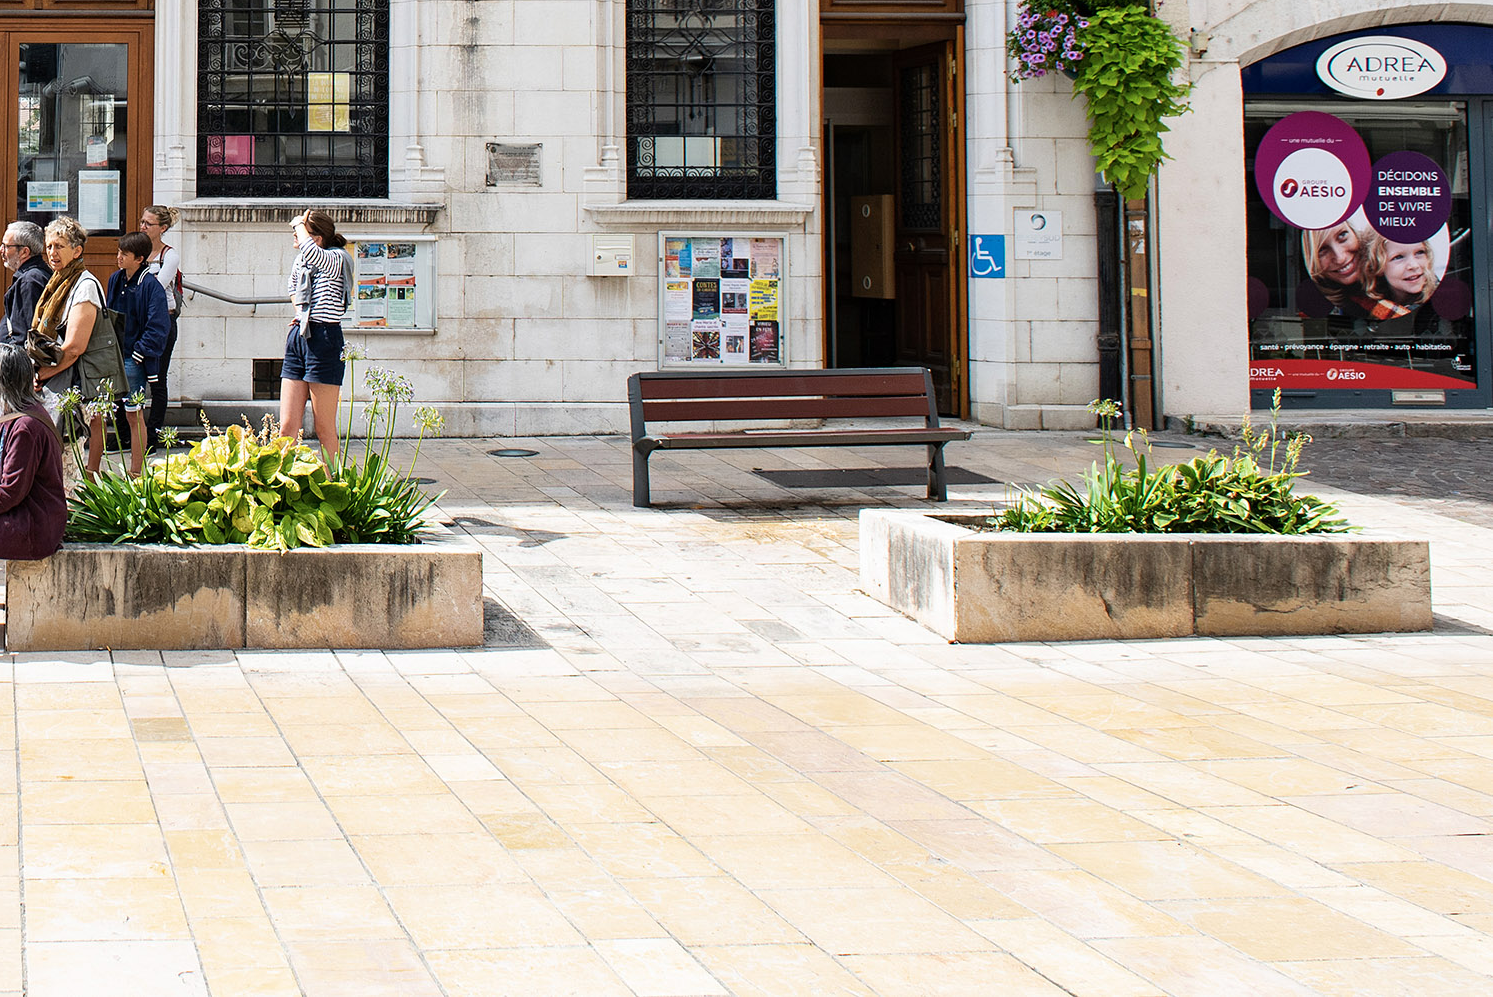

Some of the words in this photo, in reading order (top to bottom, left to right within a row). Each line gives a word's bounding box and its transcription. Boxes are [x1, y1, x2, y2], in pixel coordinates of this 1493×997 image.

[1346, 56, 1436, 73] ADREA
[1378, 169, 1439, 181] DÉCIDONS
[1299, 185, 1346, 197] AÉSIO
[1378, 186, 1441, 196] ENSEMBLE
[1378, 202, 1395, 211] DE
[1398, 202, 1433, 211] VIVRE
[1379, 217, 1416, 226] MIEUX
[1259, 343, 1280, 351] santé
[1284, 343, 1324, 352] prévoyance
[1329, 343, 1359, 352] épargne
[1364, 343, 1390, 351] retraite
[1415, 343, 1452, 351] habitation
[1250, 367, 1285, 377] DREA
